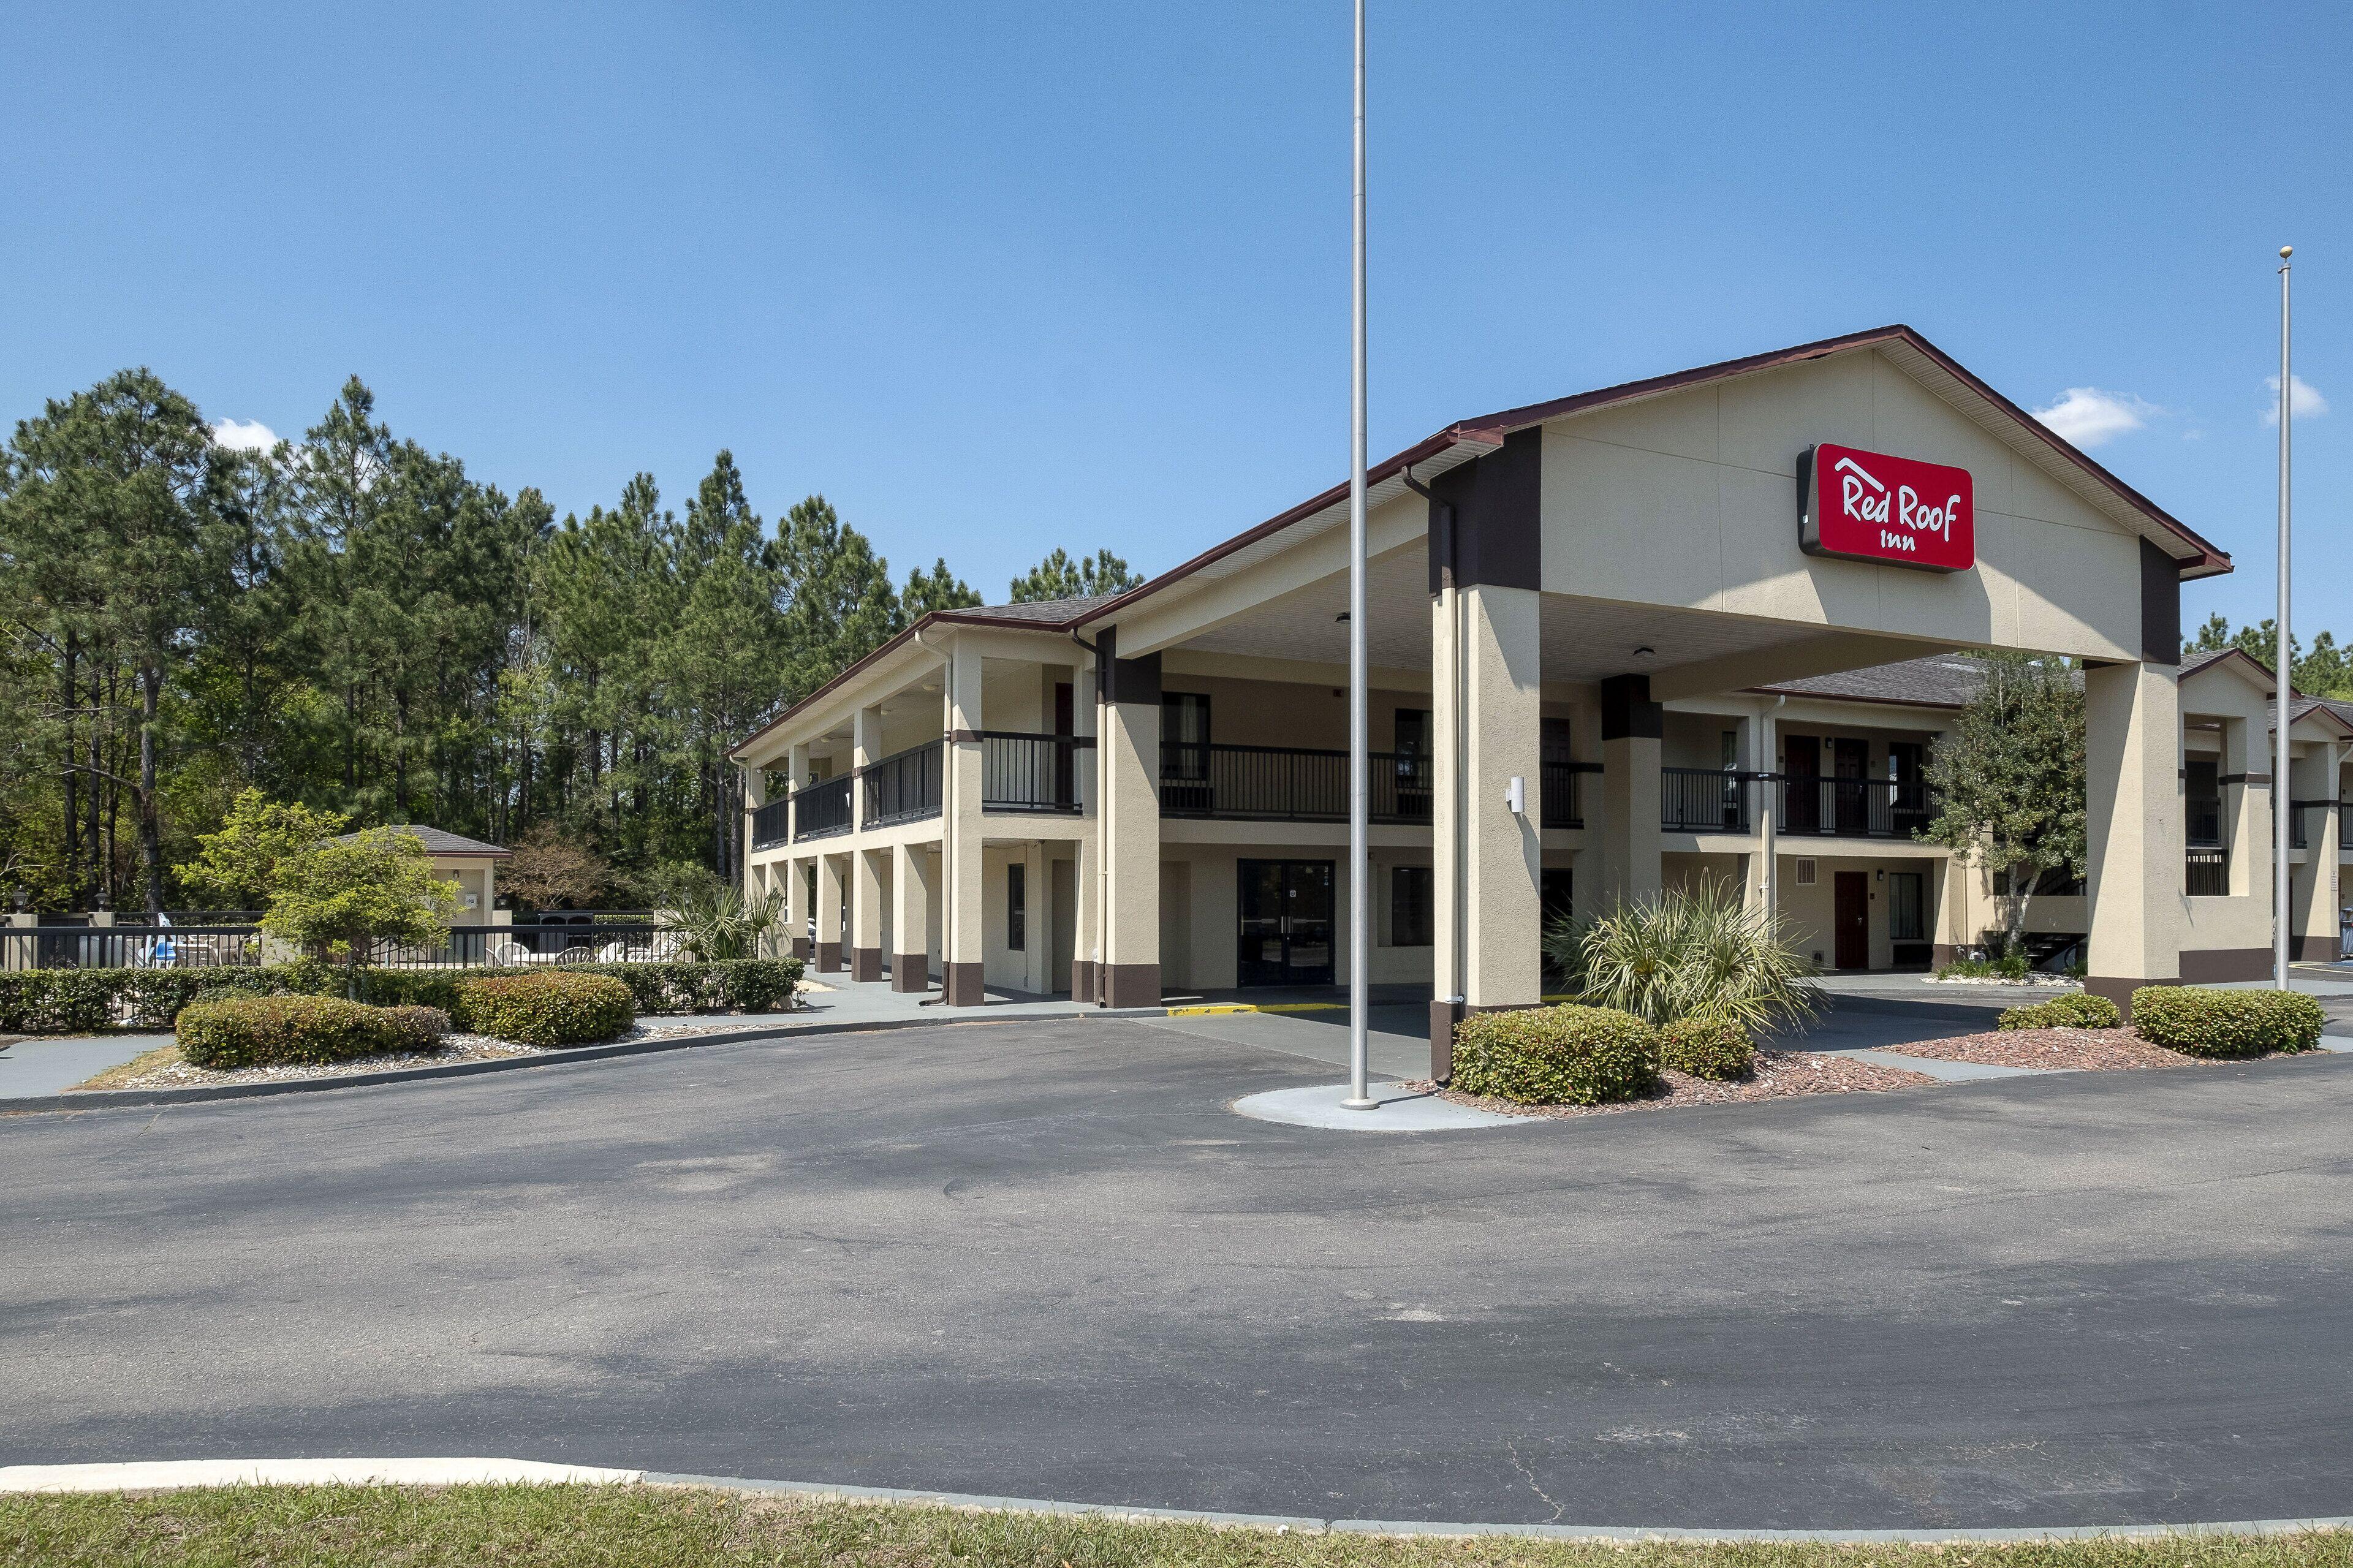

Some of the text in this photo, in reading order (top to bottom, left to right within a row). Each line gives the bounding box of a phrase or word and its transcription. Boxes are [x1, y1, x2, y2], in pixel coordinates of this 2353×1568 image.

[1843, 475, 1961, 542] Red Roof
[1881, 529, 1916, 551] Inn
